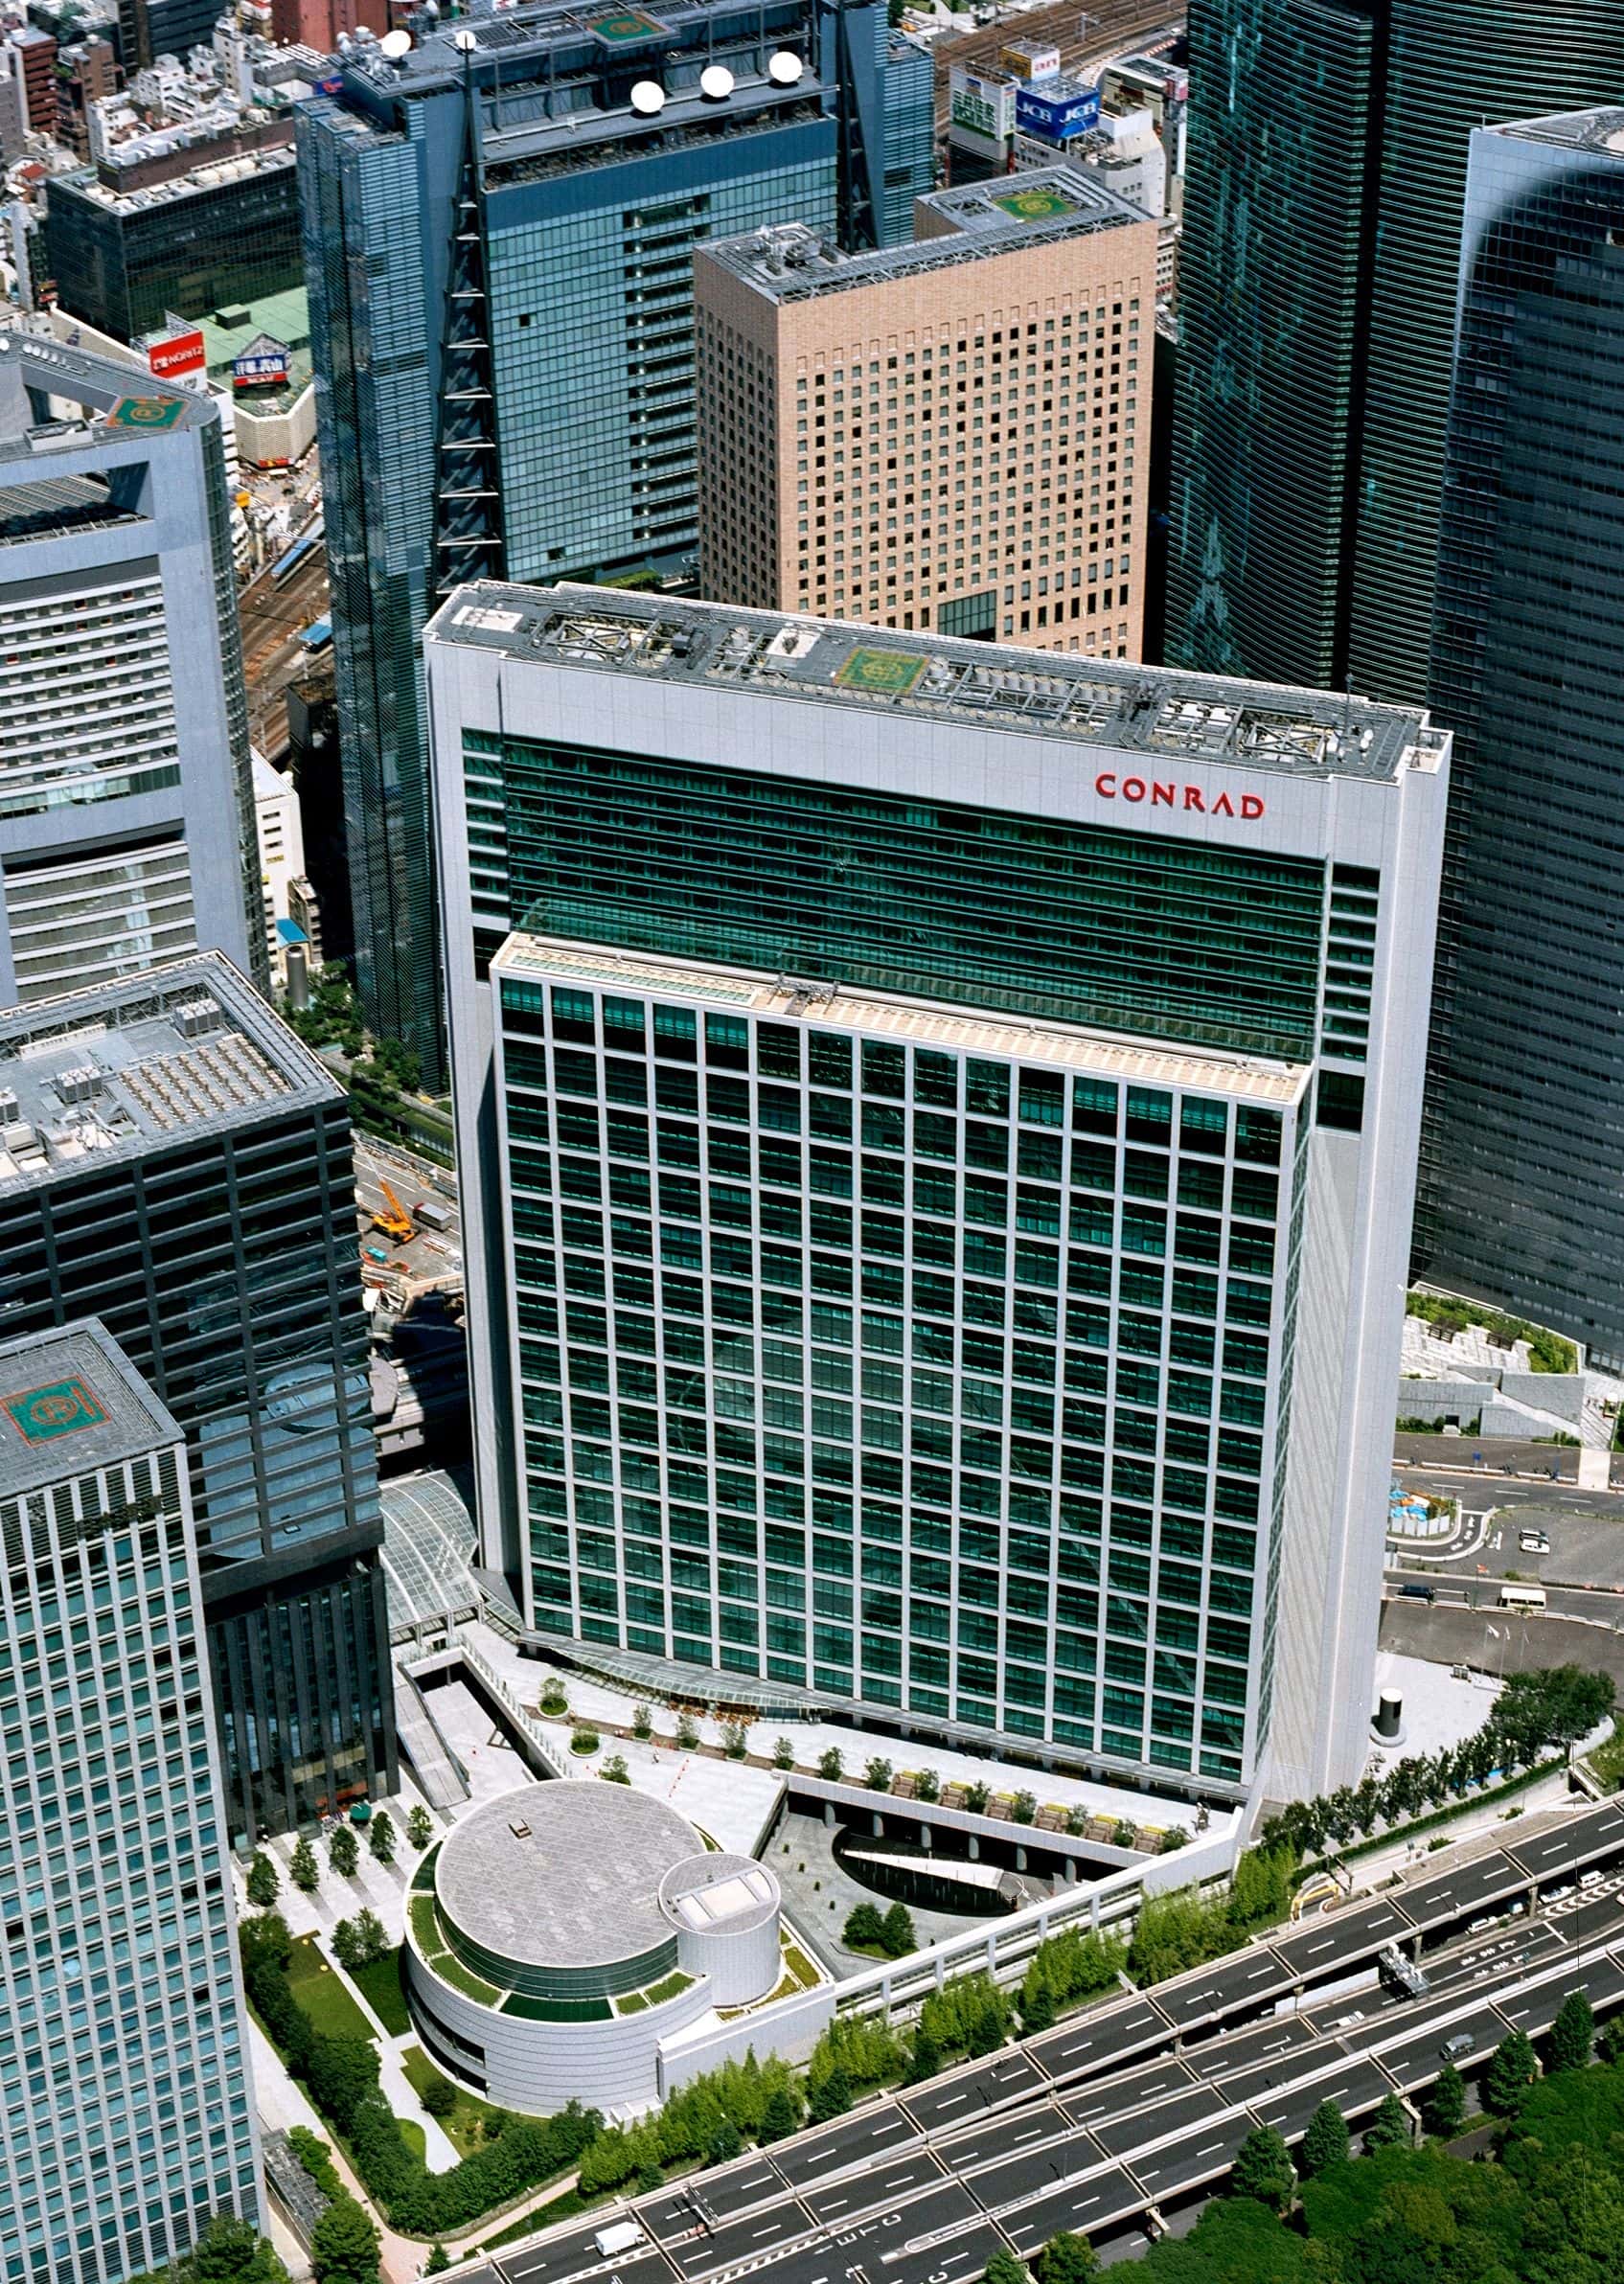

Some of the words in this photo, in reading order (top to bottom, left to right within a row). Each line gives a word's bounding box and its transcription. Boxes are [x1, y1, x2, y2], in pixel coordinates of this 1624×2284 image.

[1018, 102, 1052, 123] JCB
[1059, 102, 1097, 123] JCB
[168, 345, 204, 366] NORITZ
[1095, 773, 1265, 820] CONRAD
[836, 2214, 902, 2247] ETC
